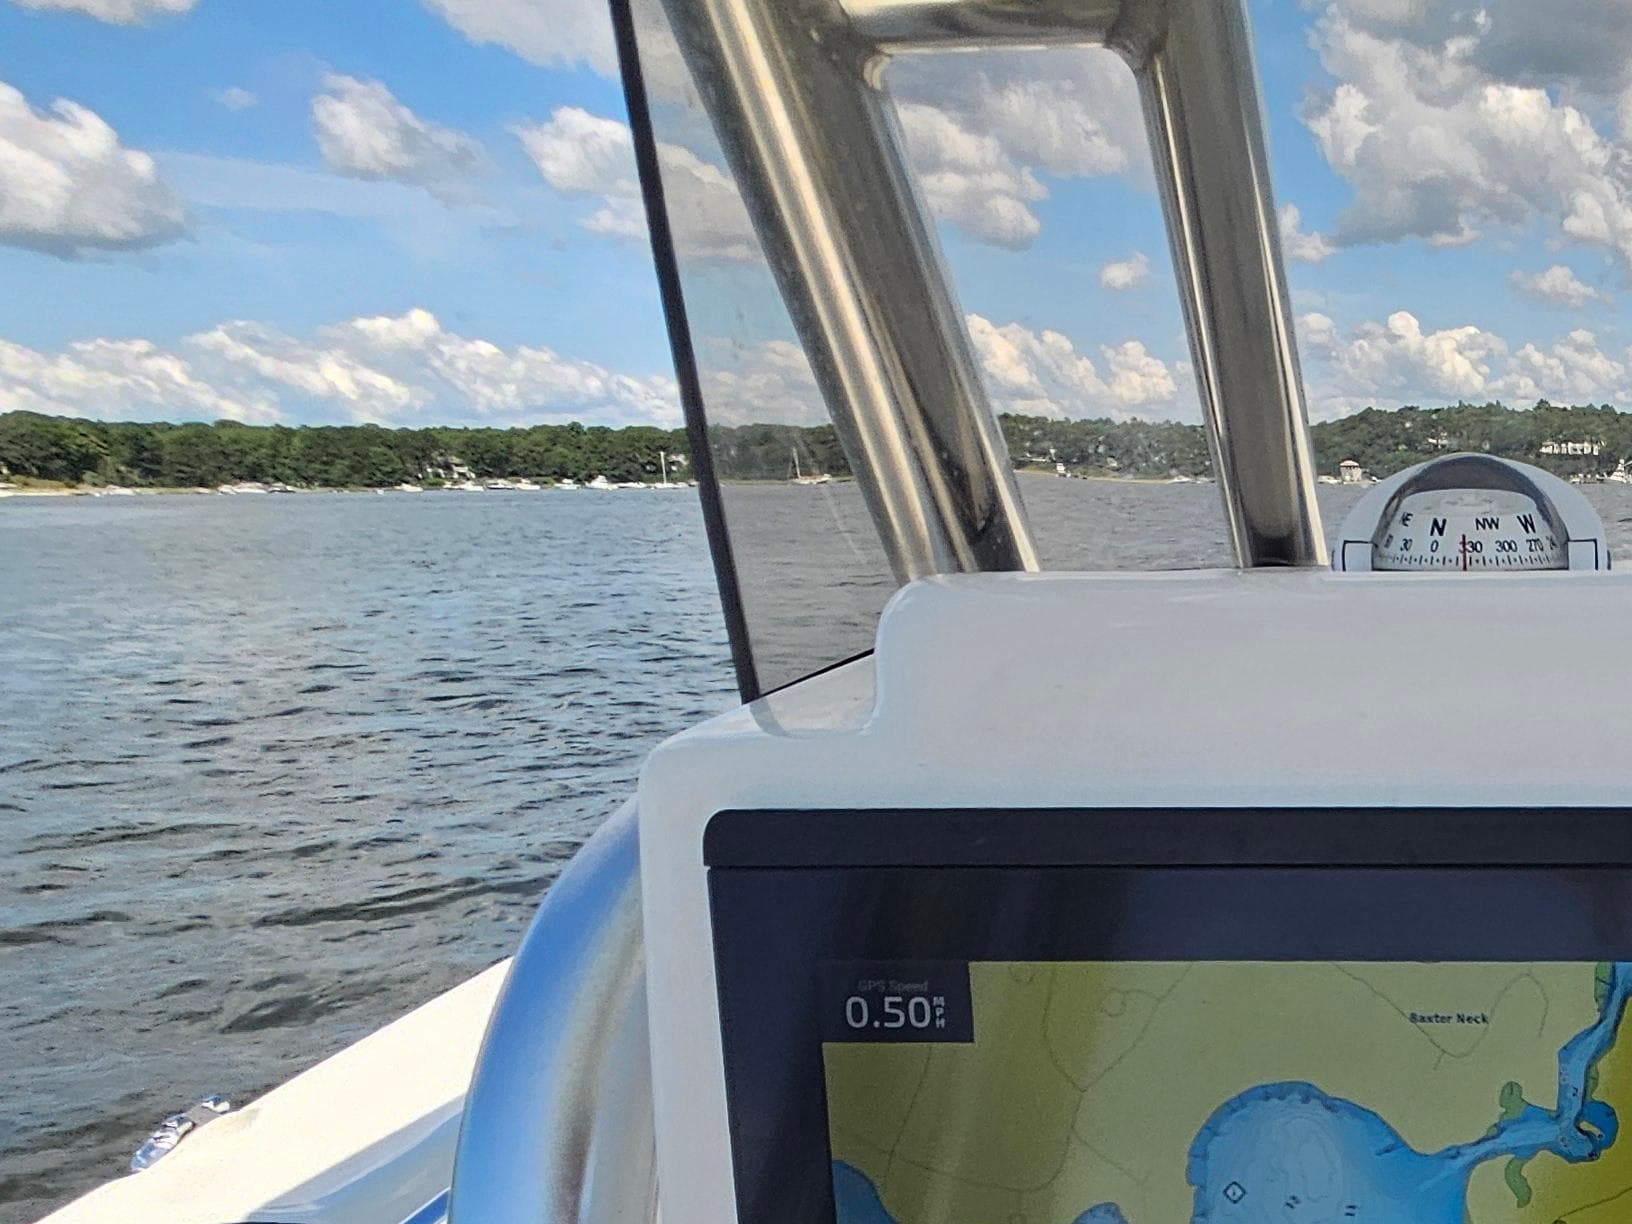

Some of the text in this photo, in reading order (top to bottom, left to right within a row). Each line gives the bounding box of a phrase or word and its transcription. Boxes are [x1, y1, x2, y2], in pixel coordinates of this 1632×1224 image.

[1430, 517, 1447, 536] N
[1475, 517, 1499, 530] NW
[1517, 513, 1536, 534] W
[1495, 540, 1517, 552] 300
[845, 996, 932, 1028] 0.50
[1409, 1012, 1490, 1025] Baxter Neck
